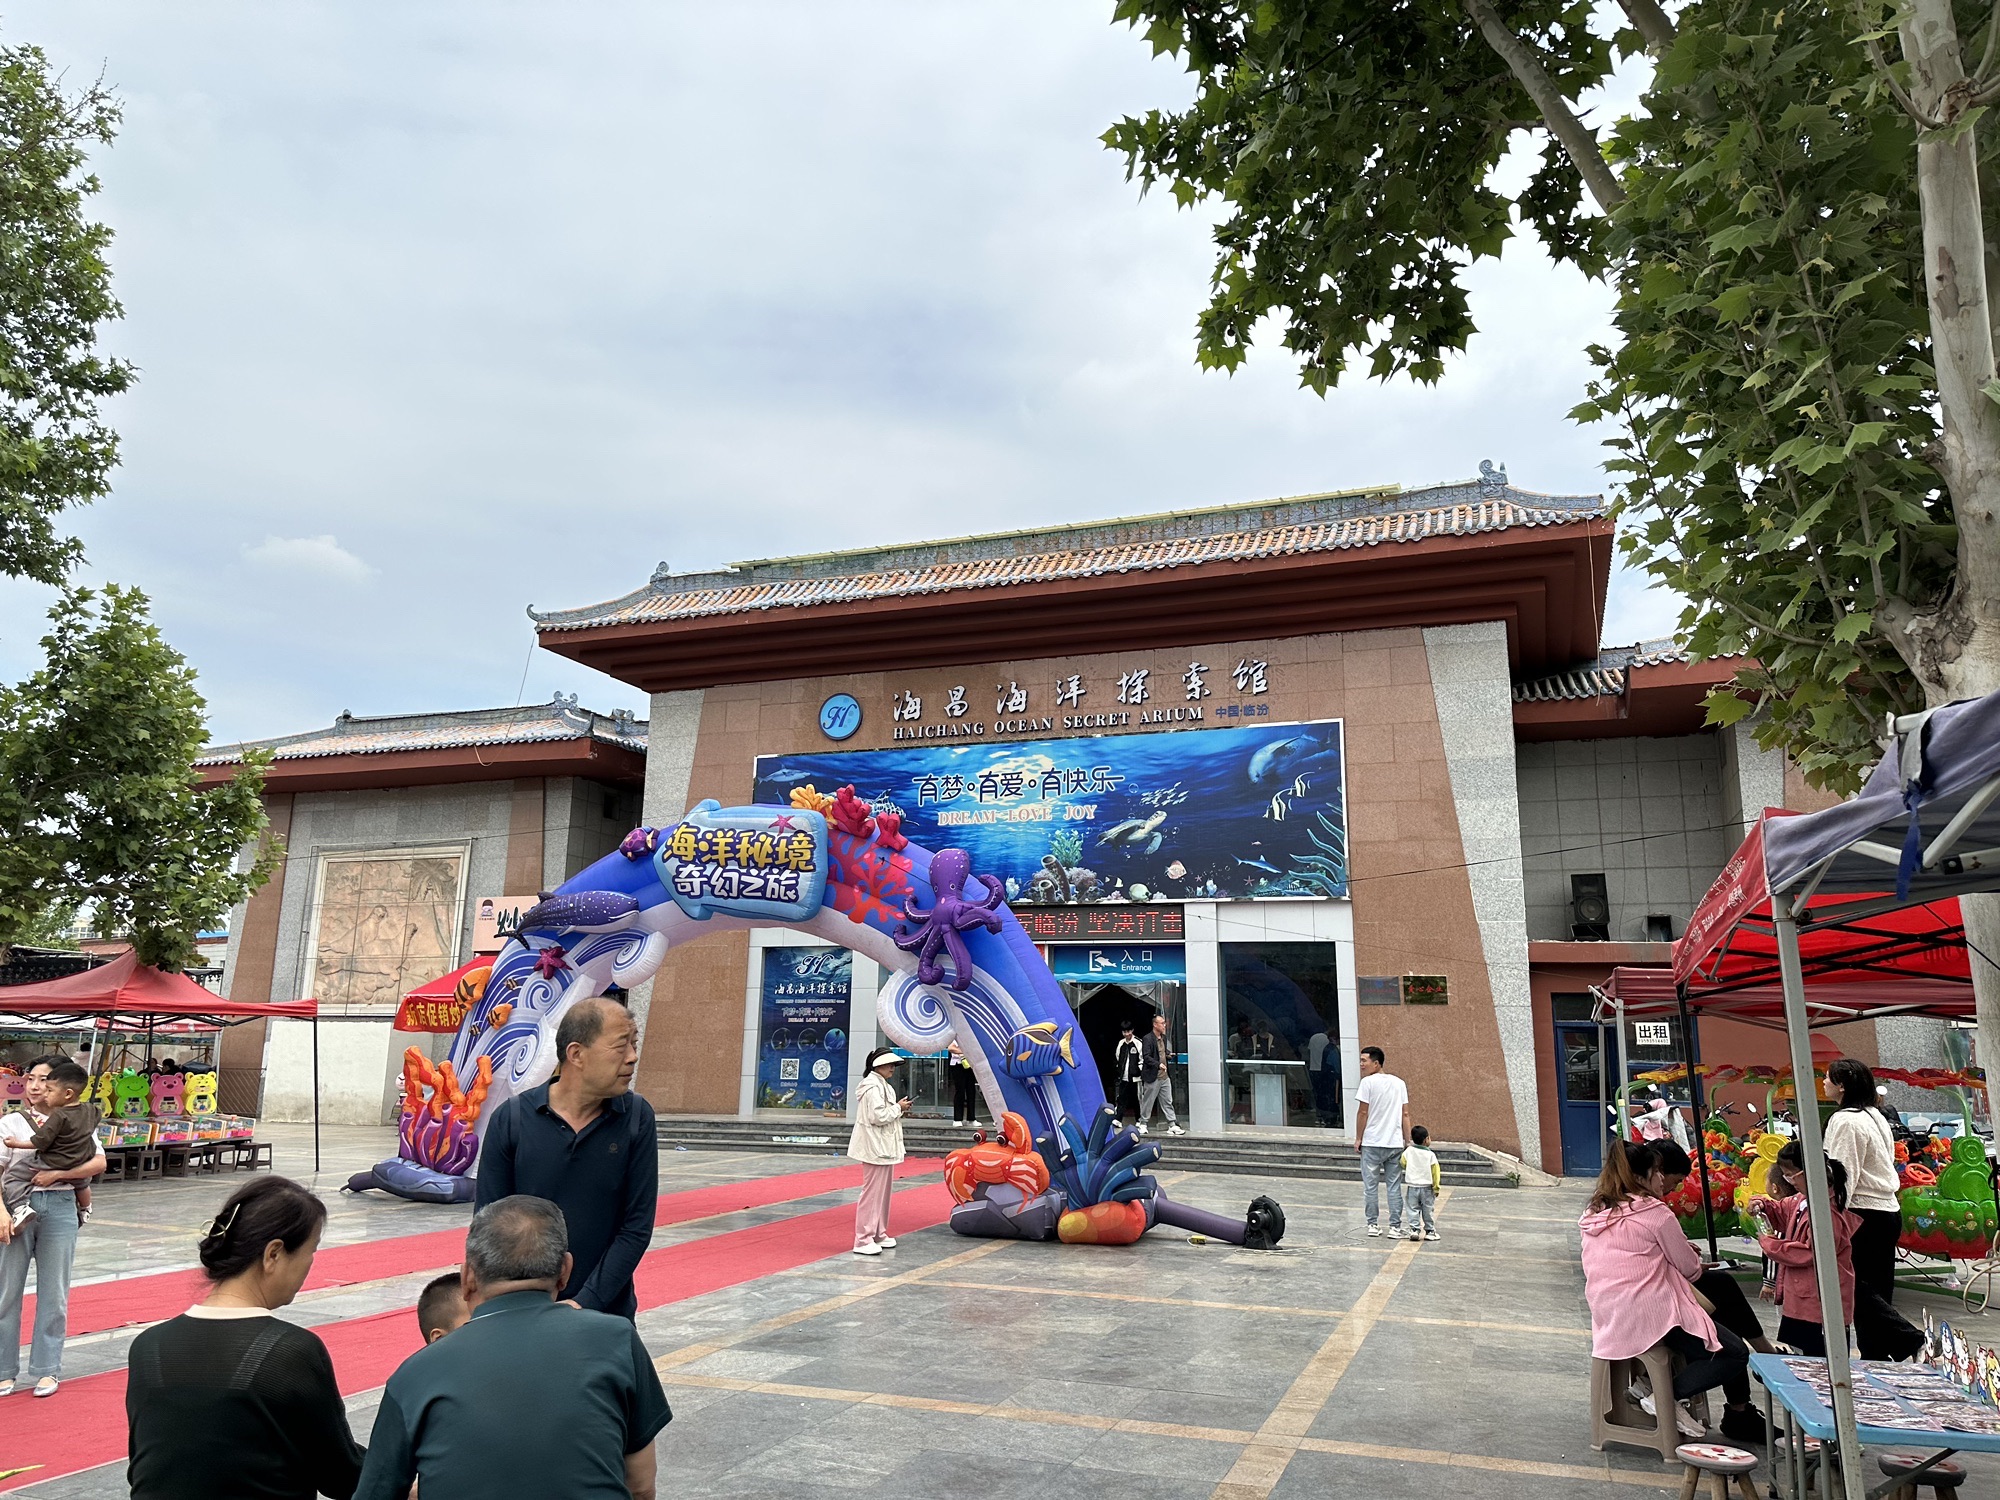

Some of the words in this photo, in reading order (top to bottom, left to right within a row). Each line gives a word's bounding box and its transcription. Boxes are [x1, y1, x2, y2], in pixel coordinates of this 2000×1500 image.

[893, 659, 1268, 722] 海昌海洋探索馆
[893, 722, 985, 740] HAICHANG
[994, 716, 1053, 734] OCEAN
[1063, 711, 1130, 729] SECRET
[1139, 707, 1204, 724] ARIUM
[937, 807, 998, 827] DREAM
[1007, 807, 1052, 823] LOVE
[1063, 804, 1098, 821] JOY
[661, 823, 816, 872] 海洋秘境
[674, 864, 799, 901] 奇幻之旅
[1087, 911, 1183, 936] 坚决打击
[1120, 949, 1153, 963] 入口
[1121, 964, 1152, 972] Entrance
[1638, 1024, 1668, 1038] 出租
